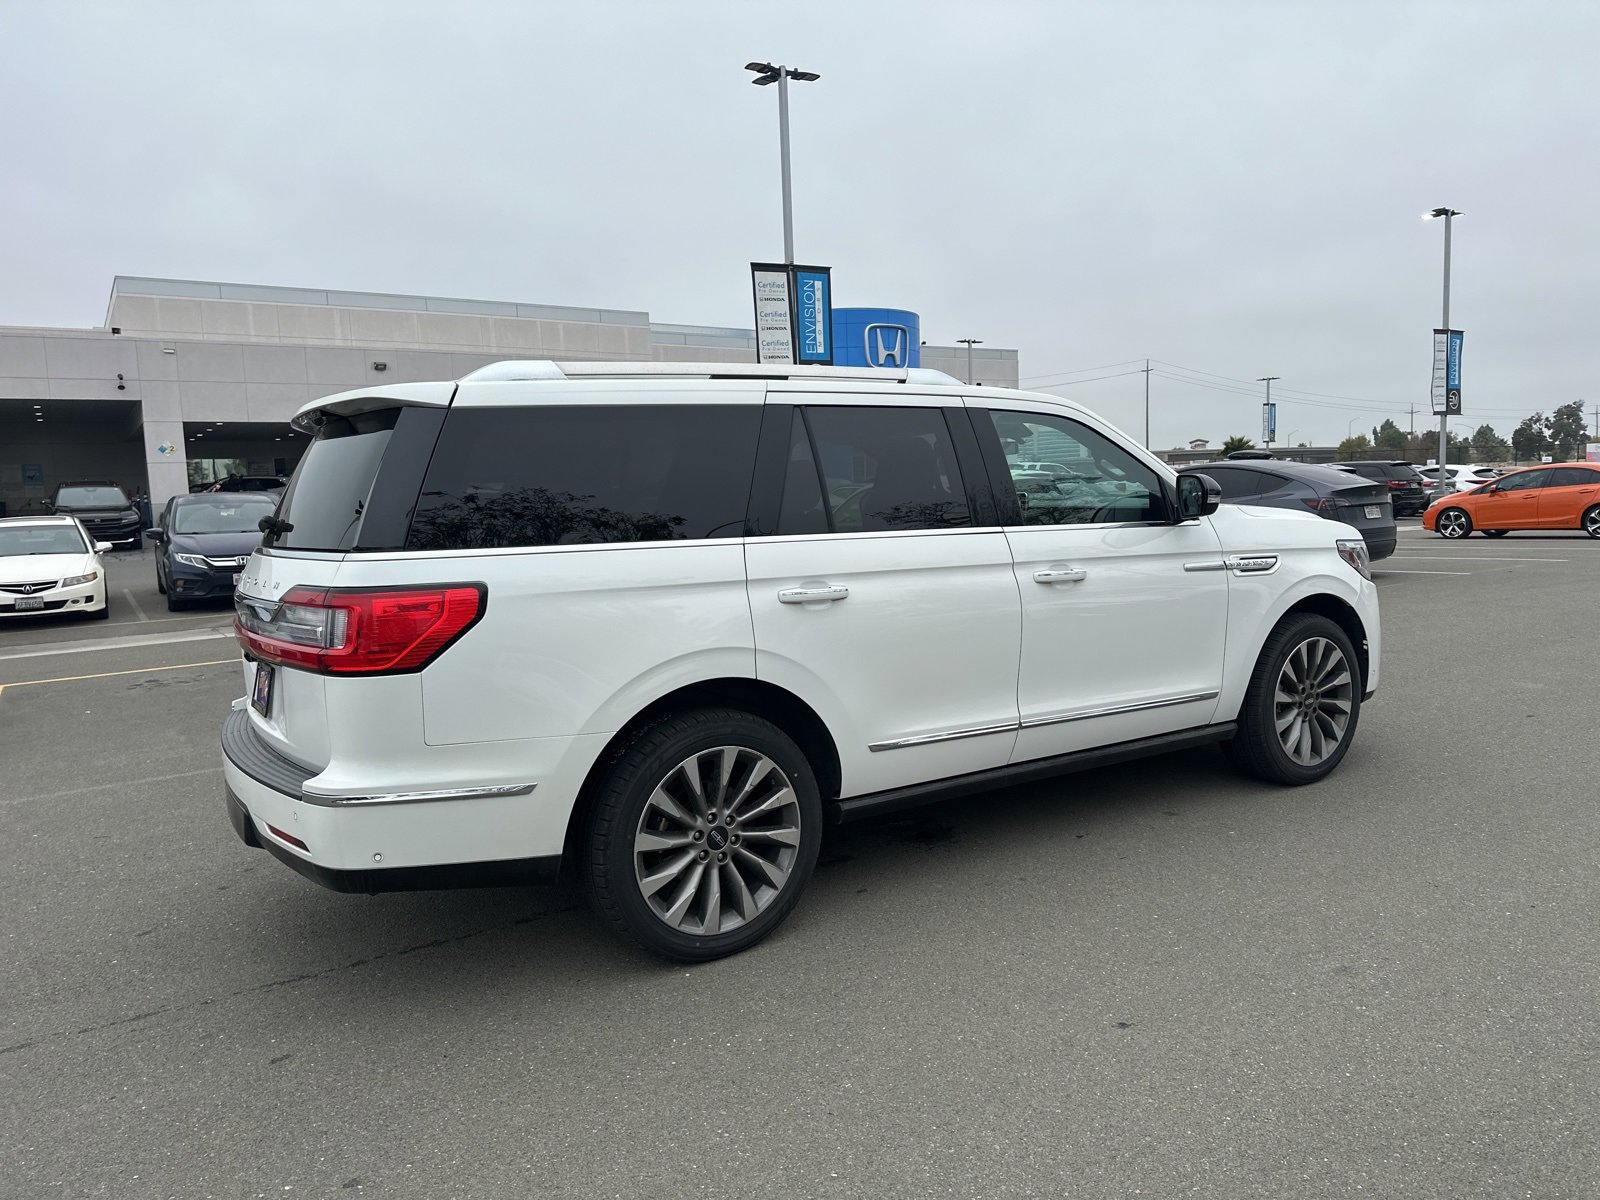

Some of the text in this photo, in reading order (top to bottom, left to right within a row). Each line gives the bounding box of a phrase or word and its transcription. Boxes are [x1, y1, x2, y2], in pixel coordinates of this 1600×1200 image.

[757, 281, 785, 289] Certified
[759, 310, 787, 318] Certified
[803, 279, 816, 354] ENVISION
[761, 339, 789, 347] Certified
